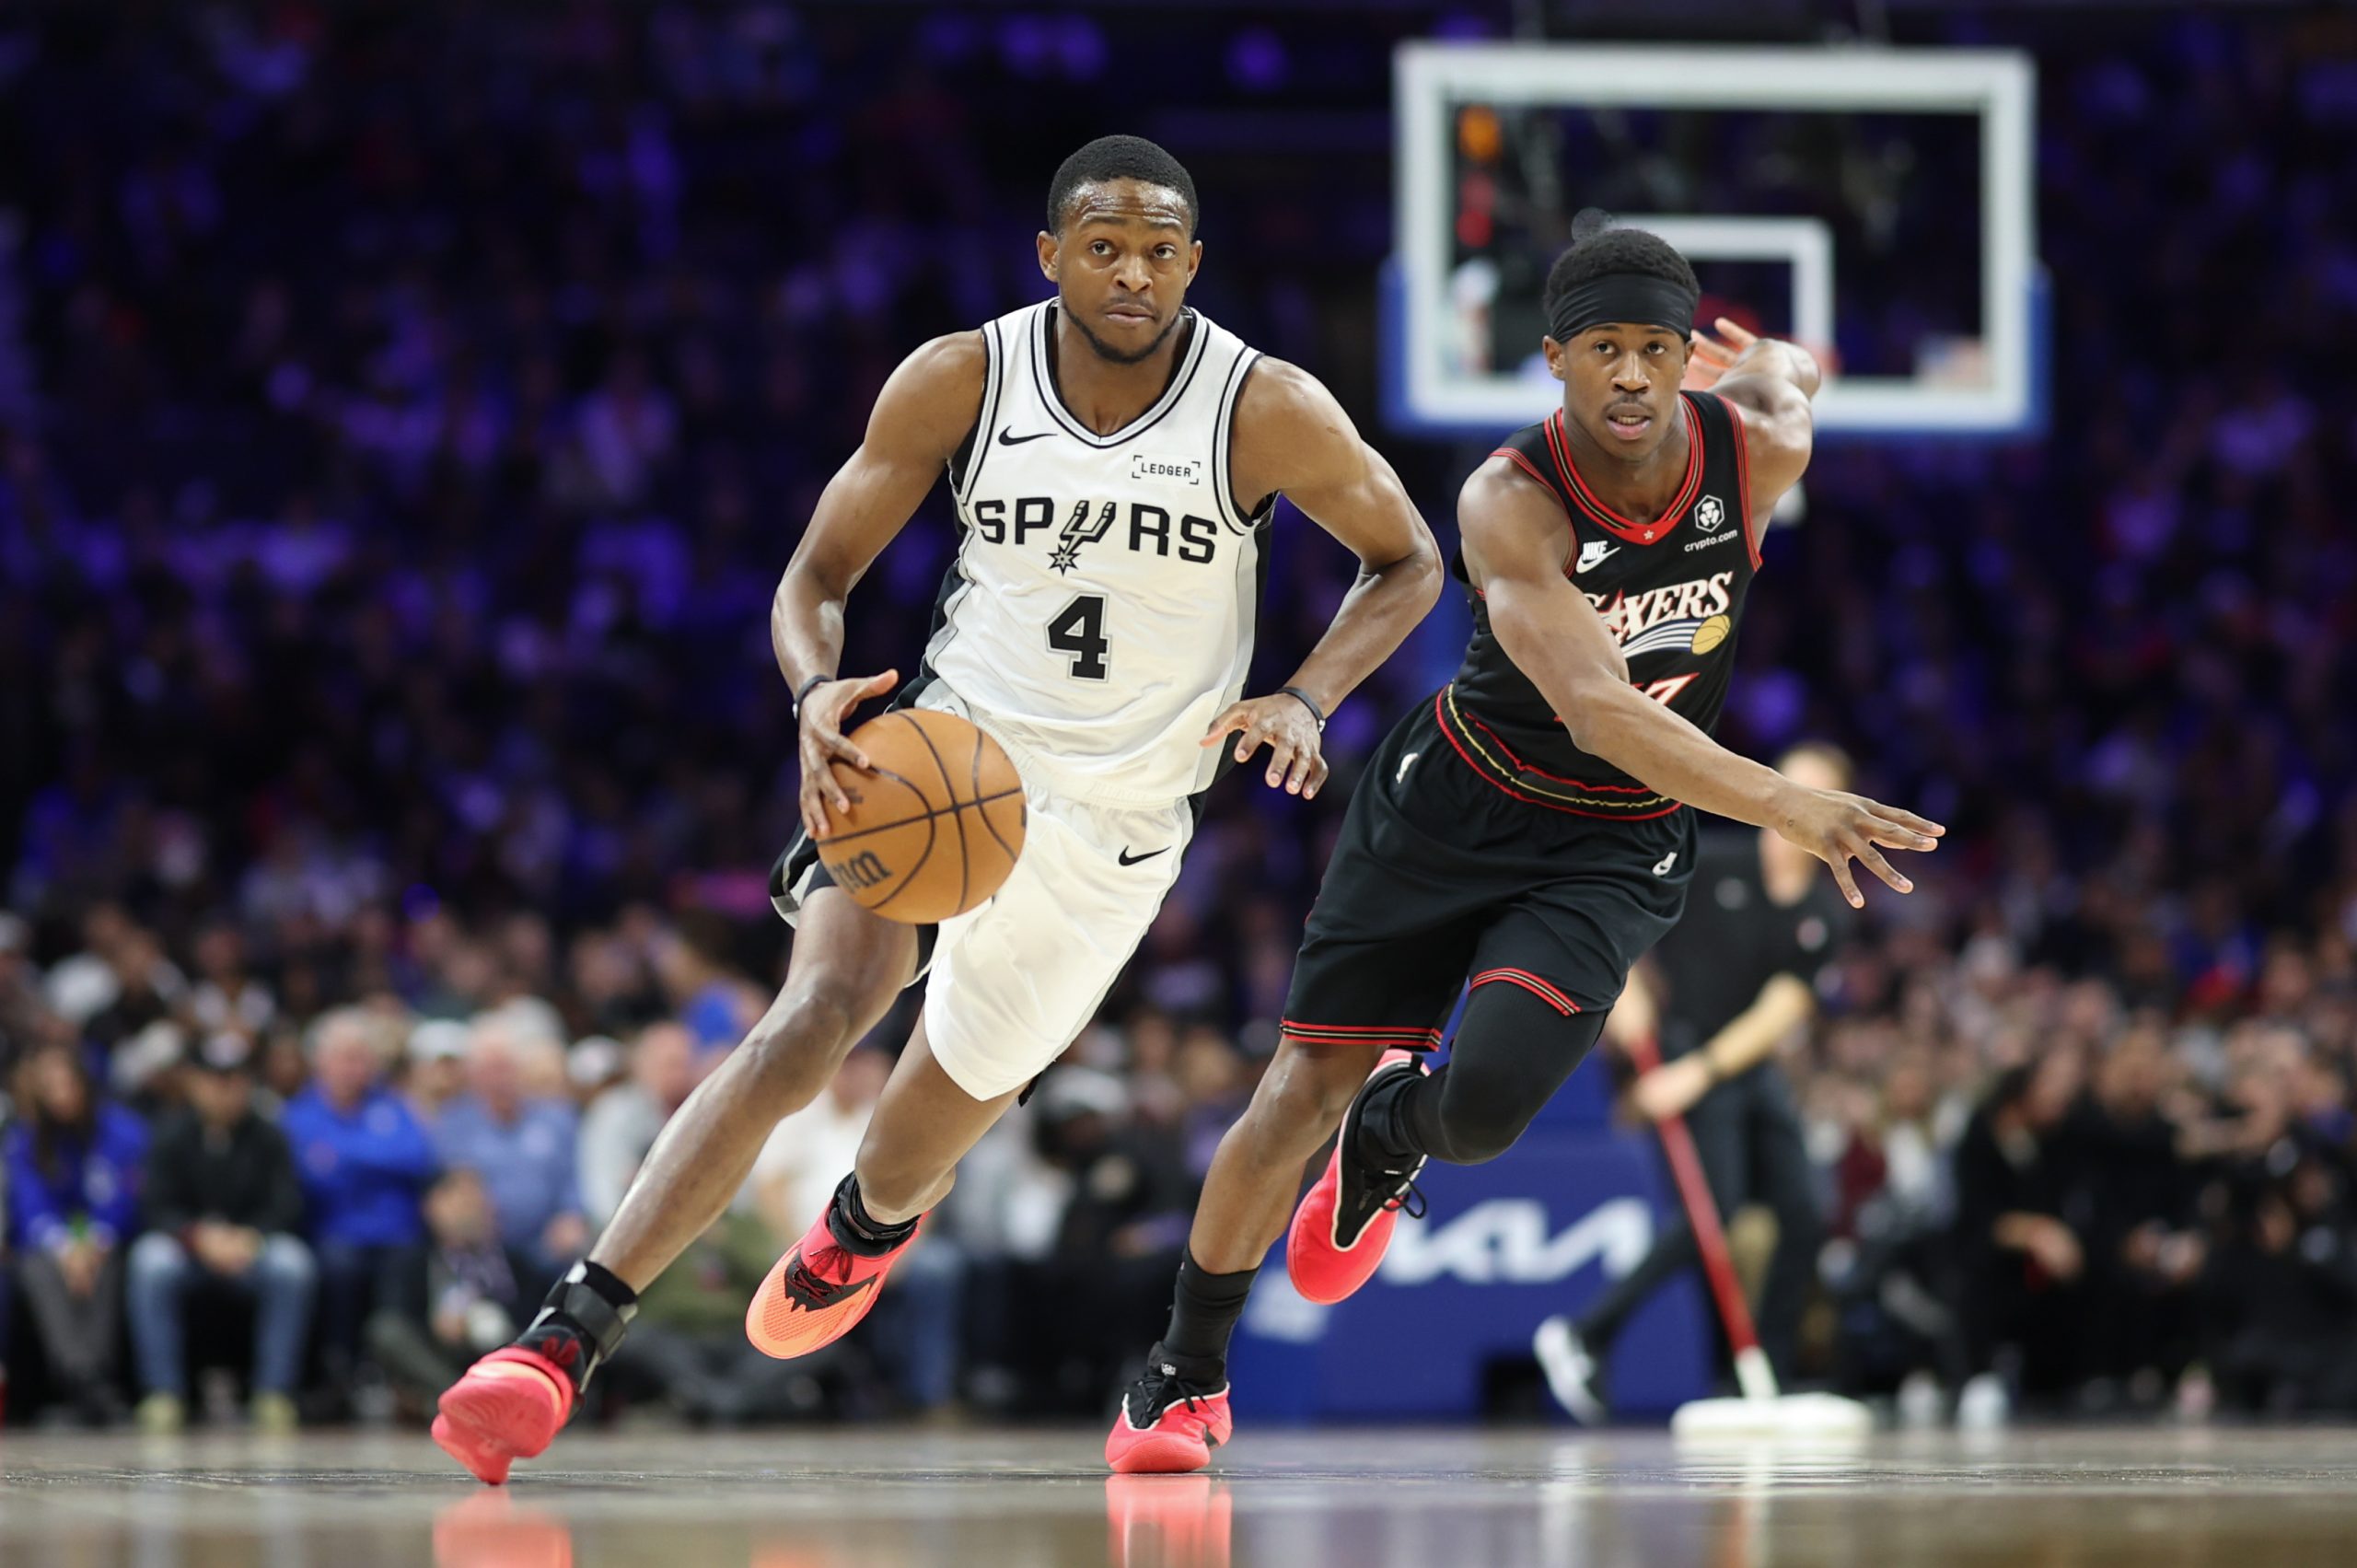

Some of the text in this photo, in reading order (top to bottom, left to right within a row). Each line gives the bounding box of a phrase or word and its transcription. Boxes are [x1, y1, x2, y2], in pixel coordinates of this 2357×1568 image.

[1140, 461, 1192, 478] LEDGER
[974, 497, 1218, 576] SPURS
[1684, 528, 1738, 552] crypto.com
[1582, 540, 1608, 561] NIKE
[1043, 589, 1113, 684] 4
